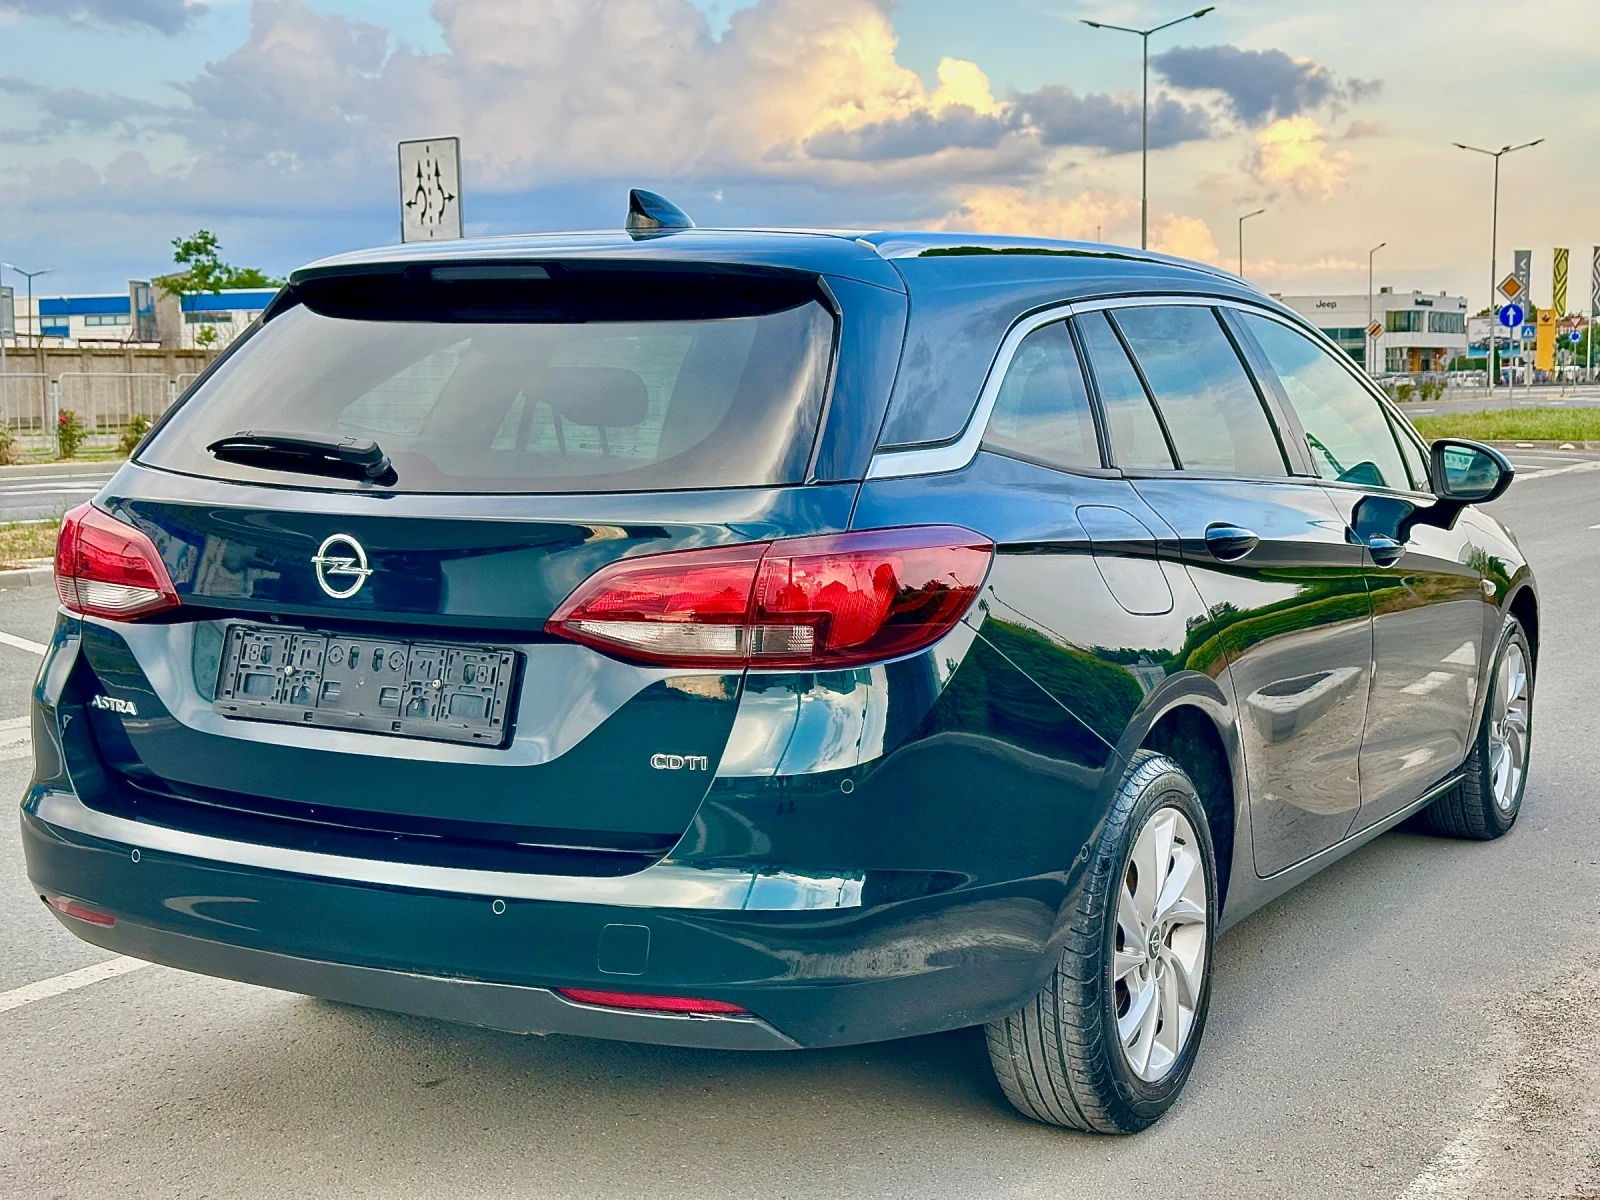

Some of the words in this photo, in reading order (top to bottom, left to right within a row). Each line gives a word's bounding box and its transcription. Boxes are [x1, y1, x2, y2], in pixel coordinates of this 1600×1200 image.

[1315, 299, 1337, 310] Jeep
[91, 694, 138, 716] ASTRA
[650, 753, 708, 771] CDTI
